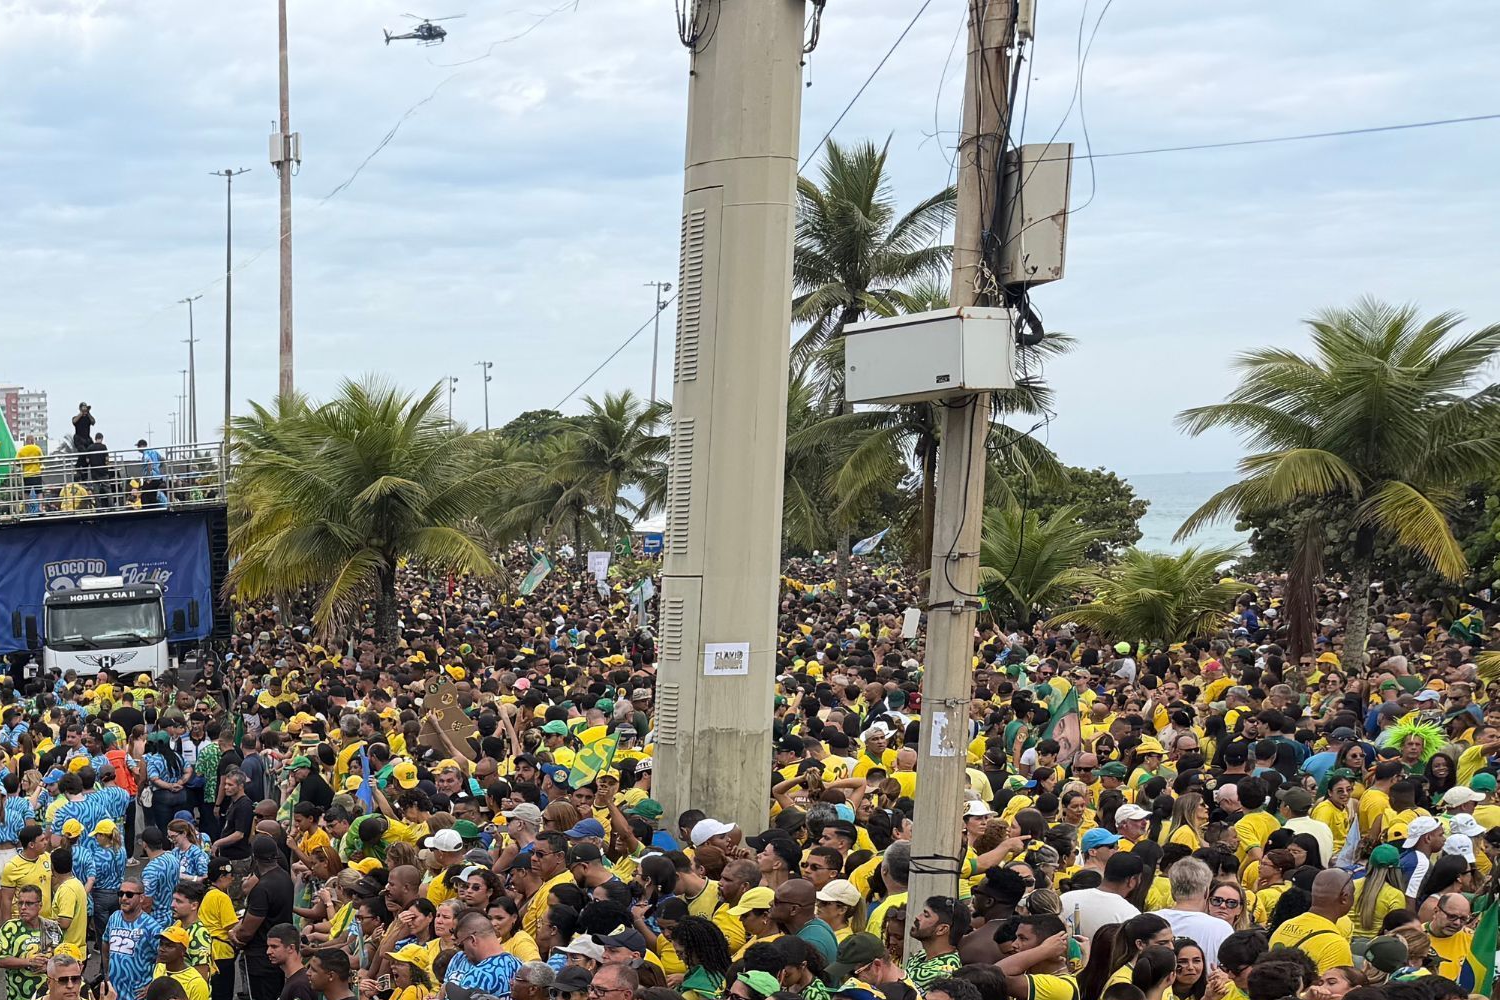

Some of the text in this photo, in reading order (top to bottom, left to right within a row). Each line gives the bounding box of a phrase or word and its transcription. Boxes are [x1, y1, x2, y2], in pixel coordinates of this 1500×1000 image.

[47, 561, 104, 577] BLOCO DO
[70, 593, 100, 602] HOBBY
[111, 591, 127, 599] CIA
